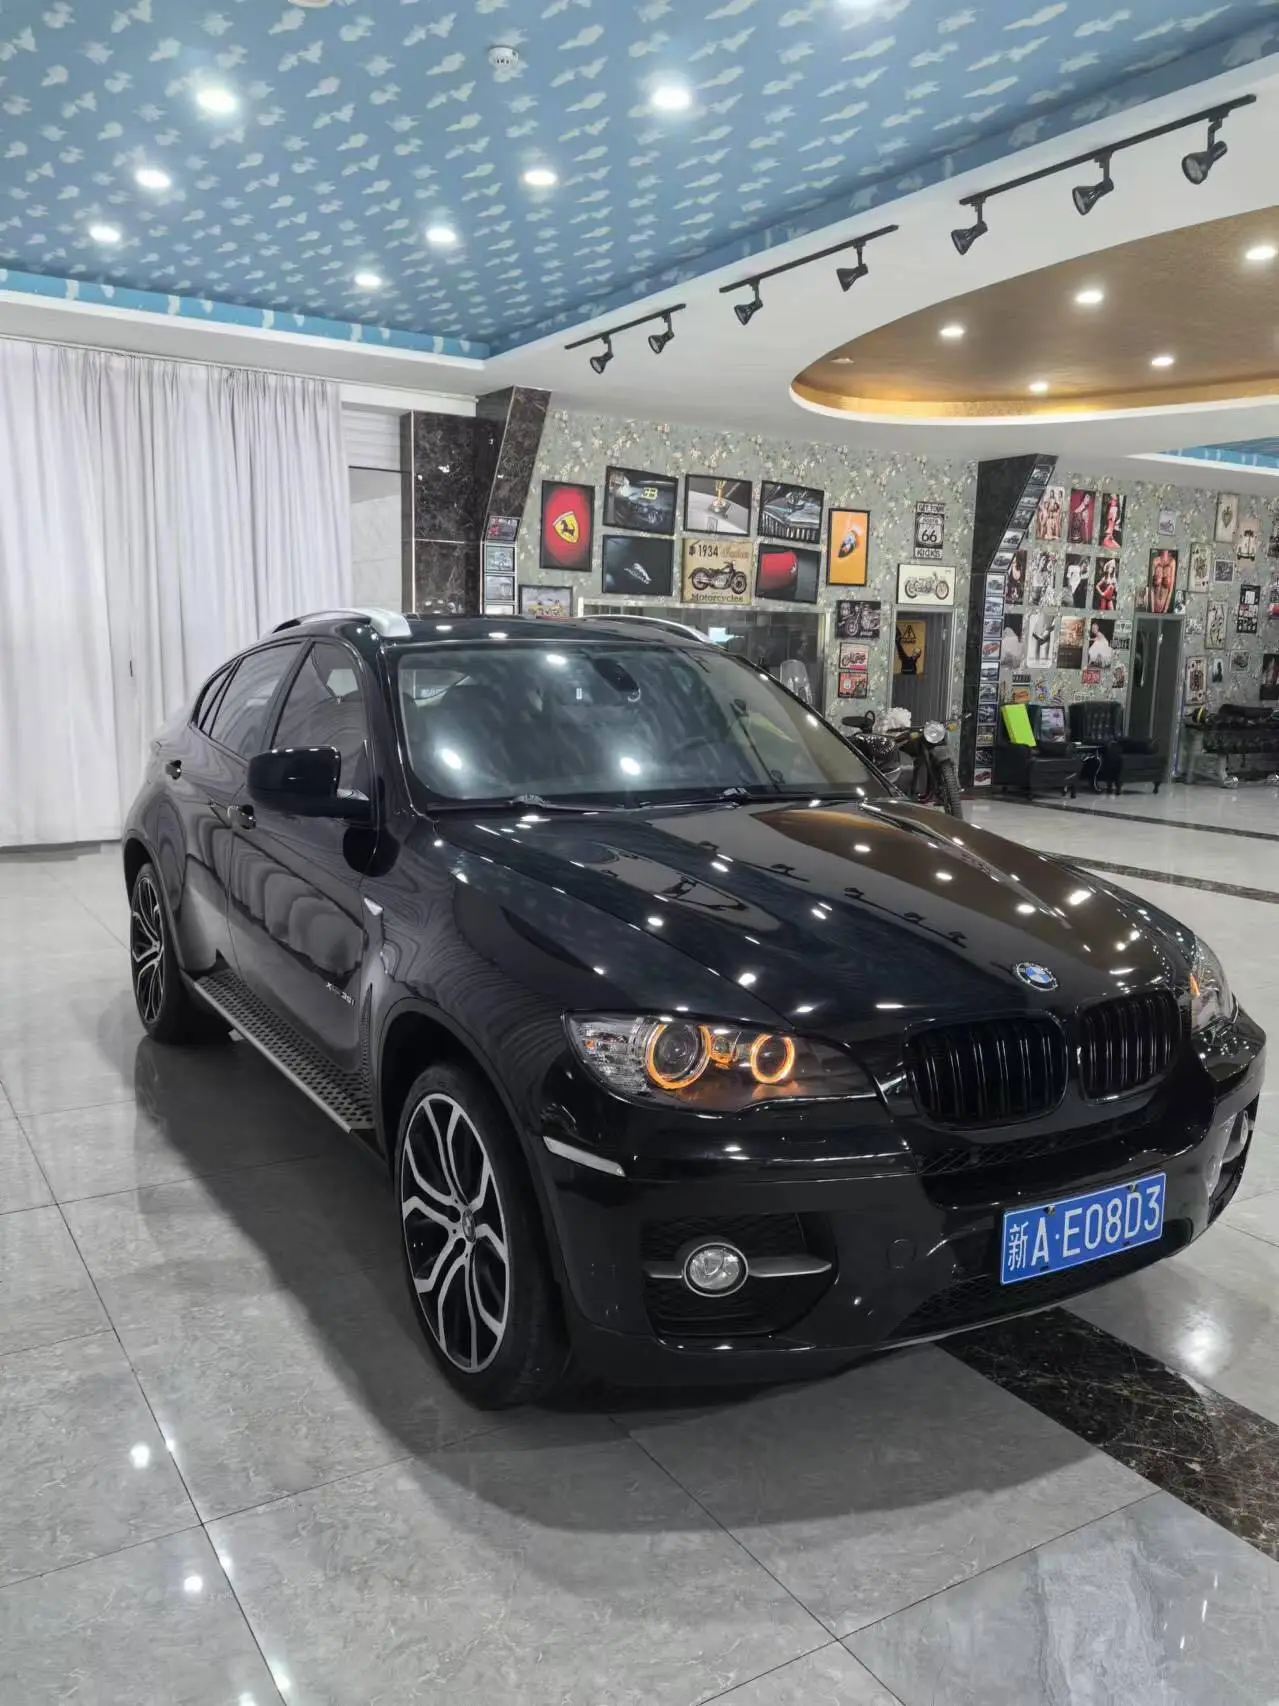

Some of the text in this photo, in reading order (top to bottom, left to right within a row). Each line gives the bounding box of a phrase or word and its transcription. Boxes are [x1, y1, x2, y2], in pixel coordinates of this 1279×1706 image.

[921, 529, 937, 542] 66
[698, 544, 718, 557] 1934
[917, 548, 940, 557] KICKS
[691, 593, 743, 602] Motorcycles
